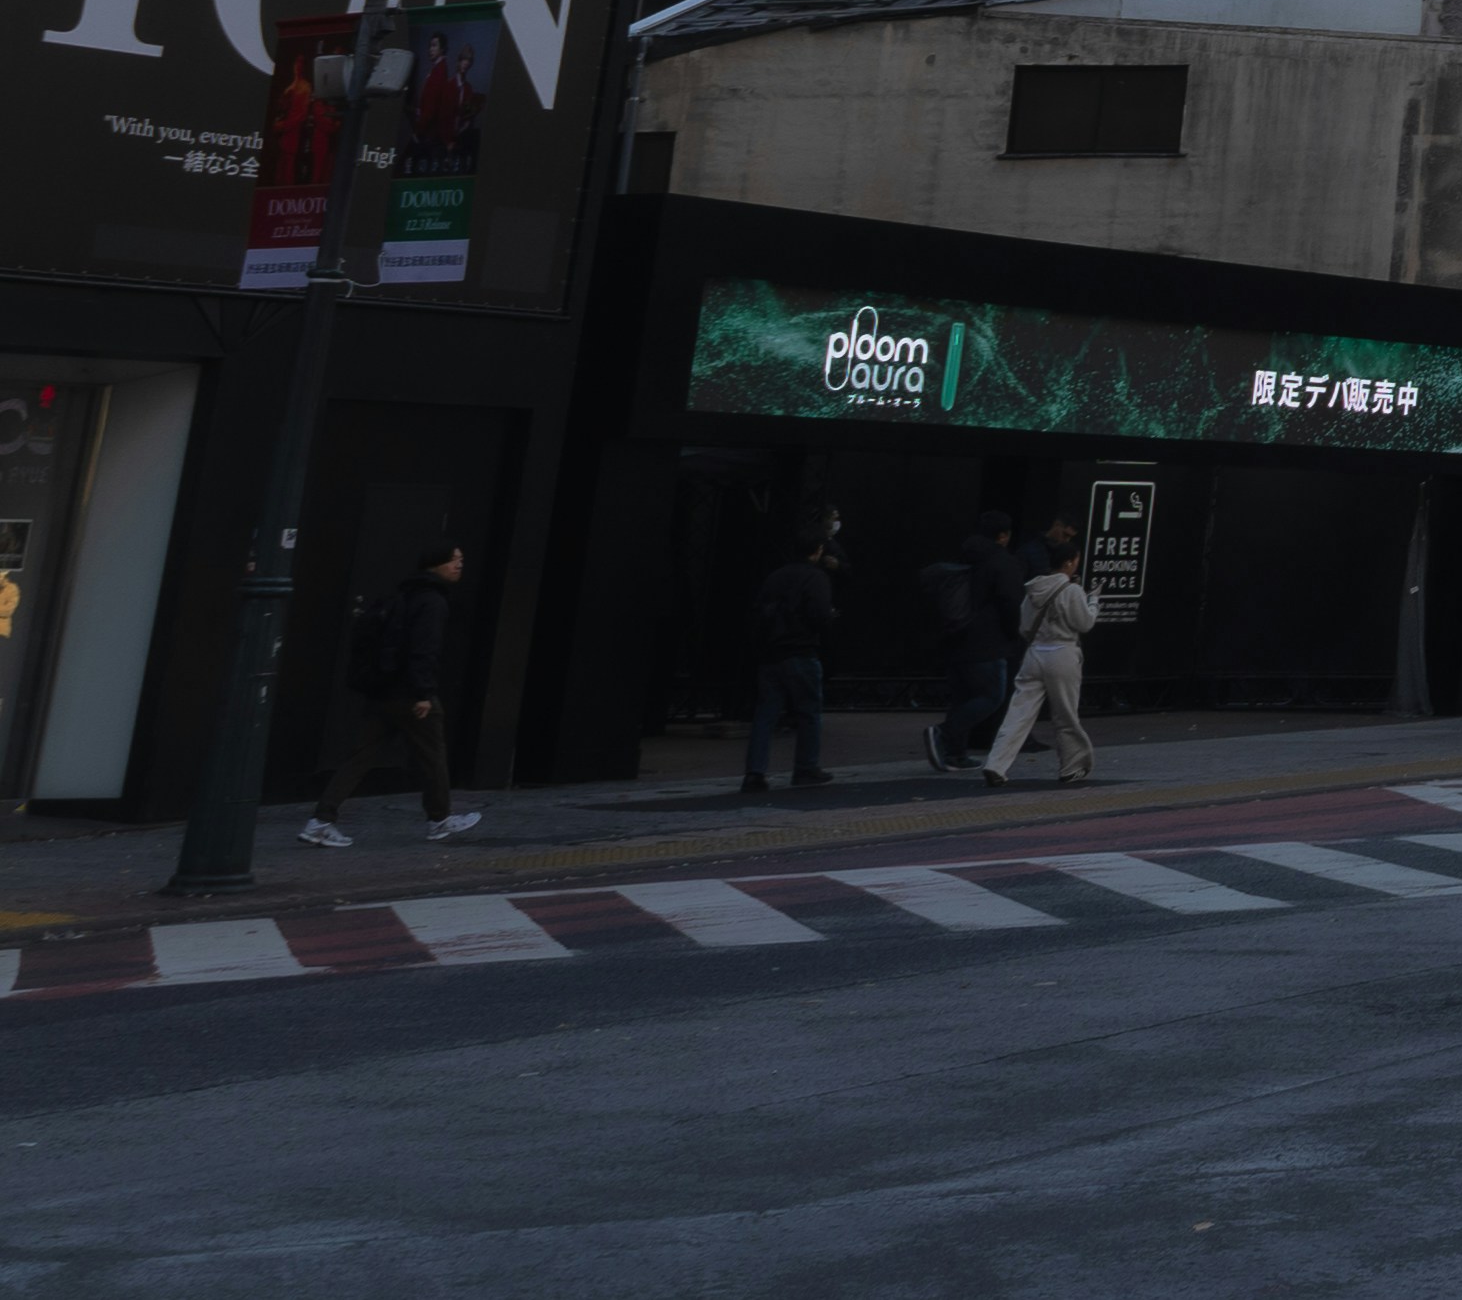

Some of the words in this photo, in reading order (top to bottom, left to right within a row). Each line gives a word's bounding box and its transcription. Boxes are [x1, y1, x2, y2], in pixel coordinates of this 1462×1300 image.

[154, 122, 197, 147] you,
[200, 128, 264, 151] everyth
[400, 188, 465, 209] DOMOTO
[825, 305, 930, 391] ploom
[851, 362, 926, 394] aura
[1094, 536, 1142, 556] FREE
[1092, 559, 1139, 572] SMOKING
[1091, 576, 1137, 589] SPACE
